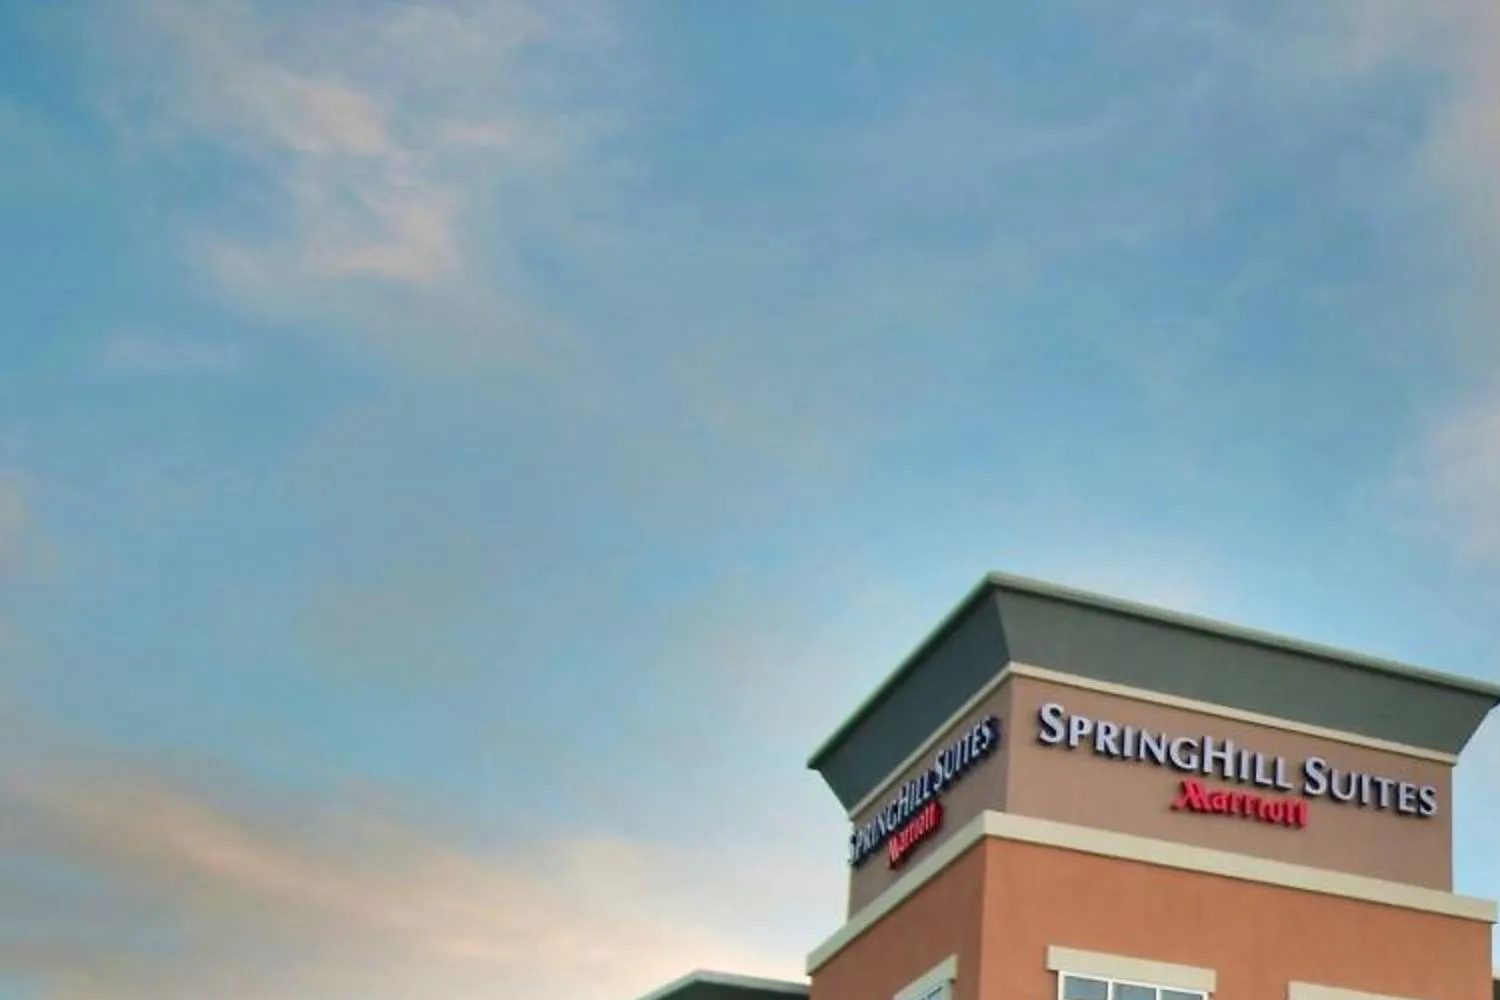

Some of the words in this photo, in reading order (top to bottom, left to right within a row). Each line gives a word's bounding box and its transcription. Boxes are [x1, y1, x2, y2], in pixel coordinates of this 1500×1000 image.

[932, 714, 998, 792] SUITES
[1037, 702, 1294, 791] SPRINGHILL
[1303, 756, 1438, 817] SUITES
[1173, 777, 1310, 828] Marriott
